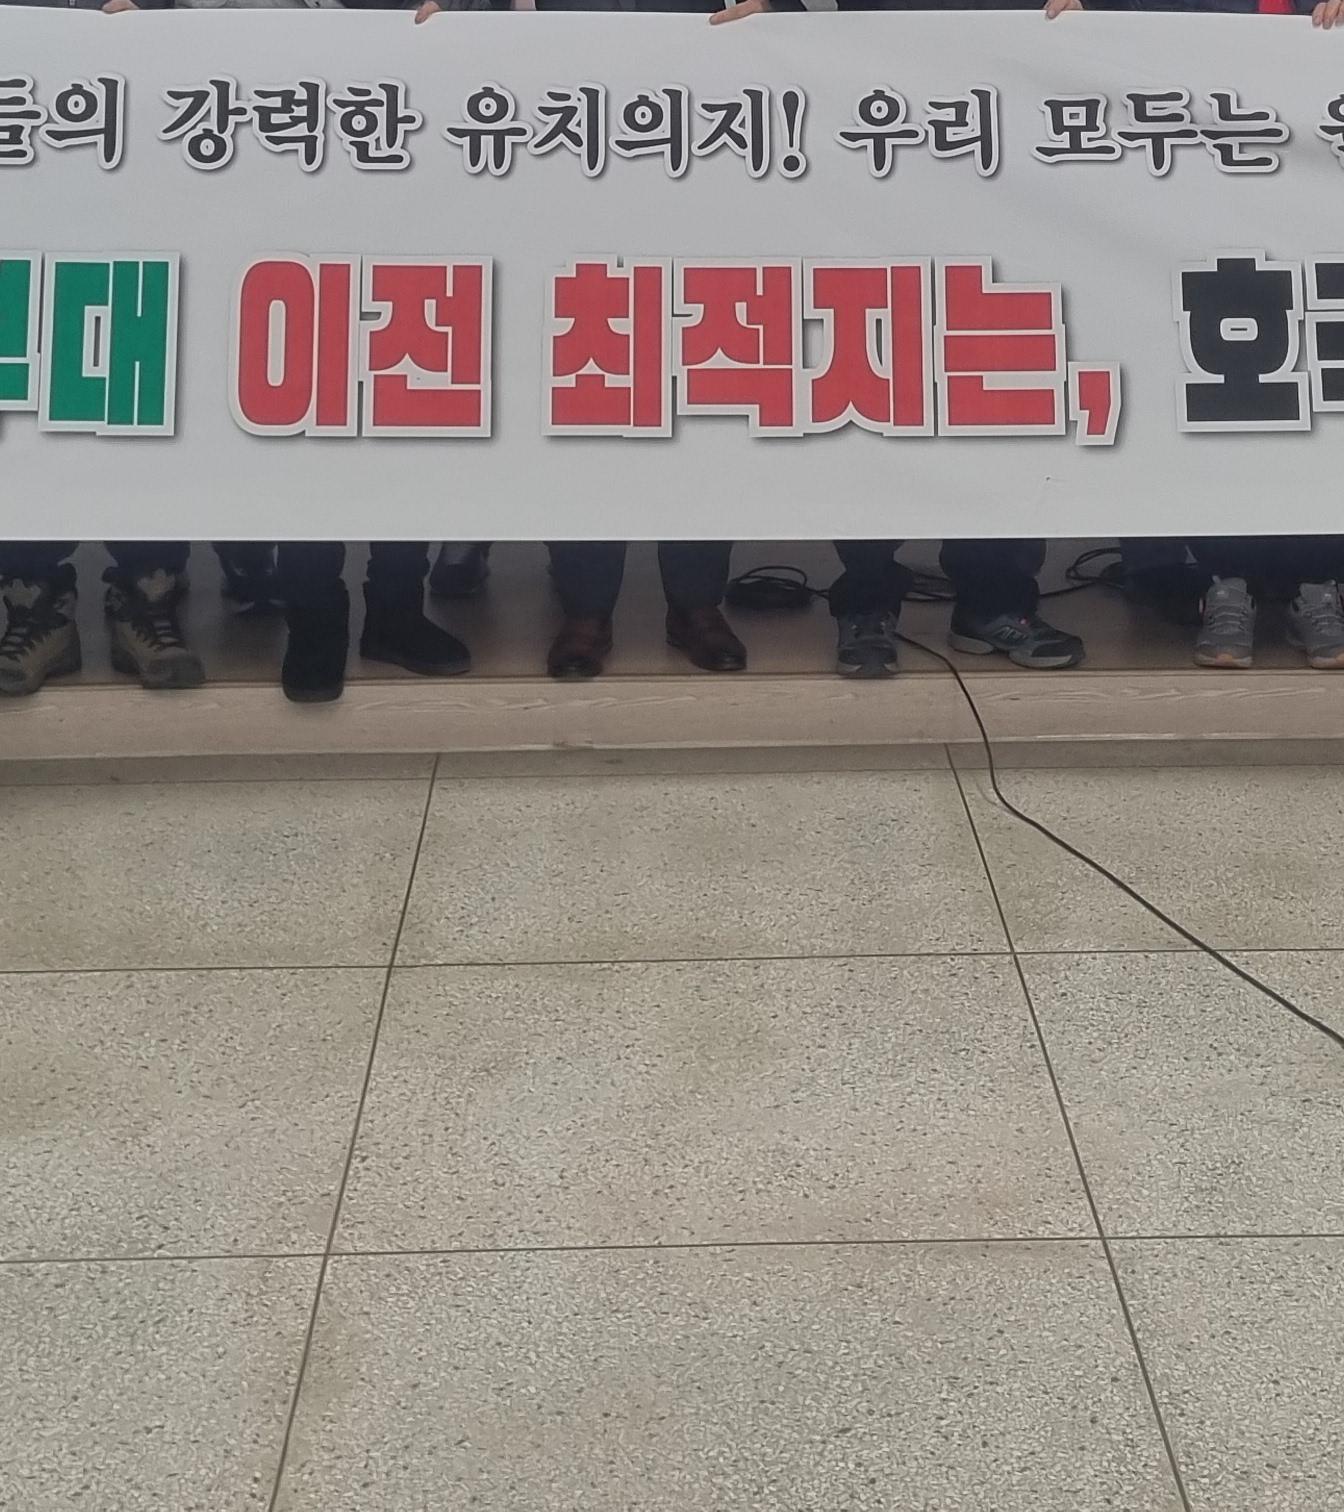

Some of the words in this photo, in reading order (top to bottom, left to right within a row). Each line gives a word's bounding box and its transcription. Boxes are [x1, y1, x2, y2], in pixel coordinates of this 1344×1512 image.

[163, 76, 423, 172] 강력한
[445, 81, 808, 177] 유치의지!
[839, 85, 1001, 178] 우리
[1032, 88, 1292, 178] 모두는
[229, 250, 493, 438] 이전
[543, 253, 1120, 446] 최적지는,
